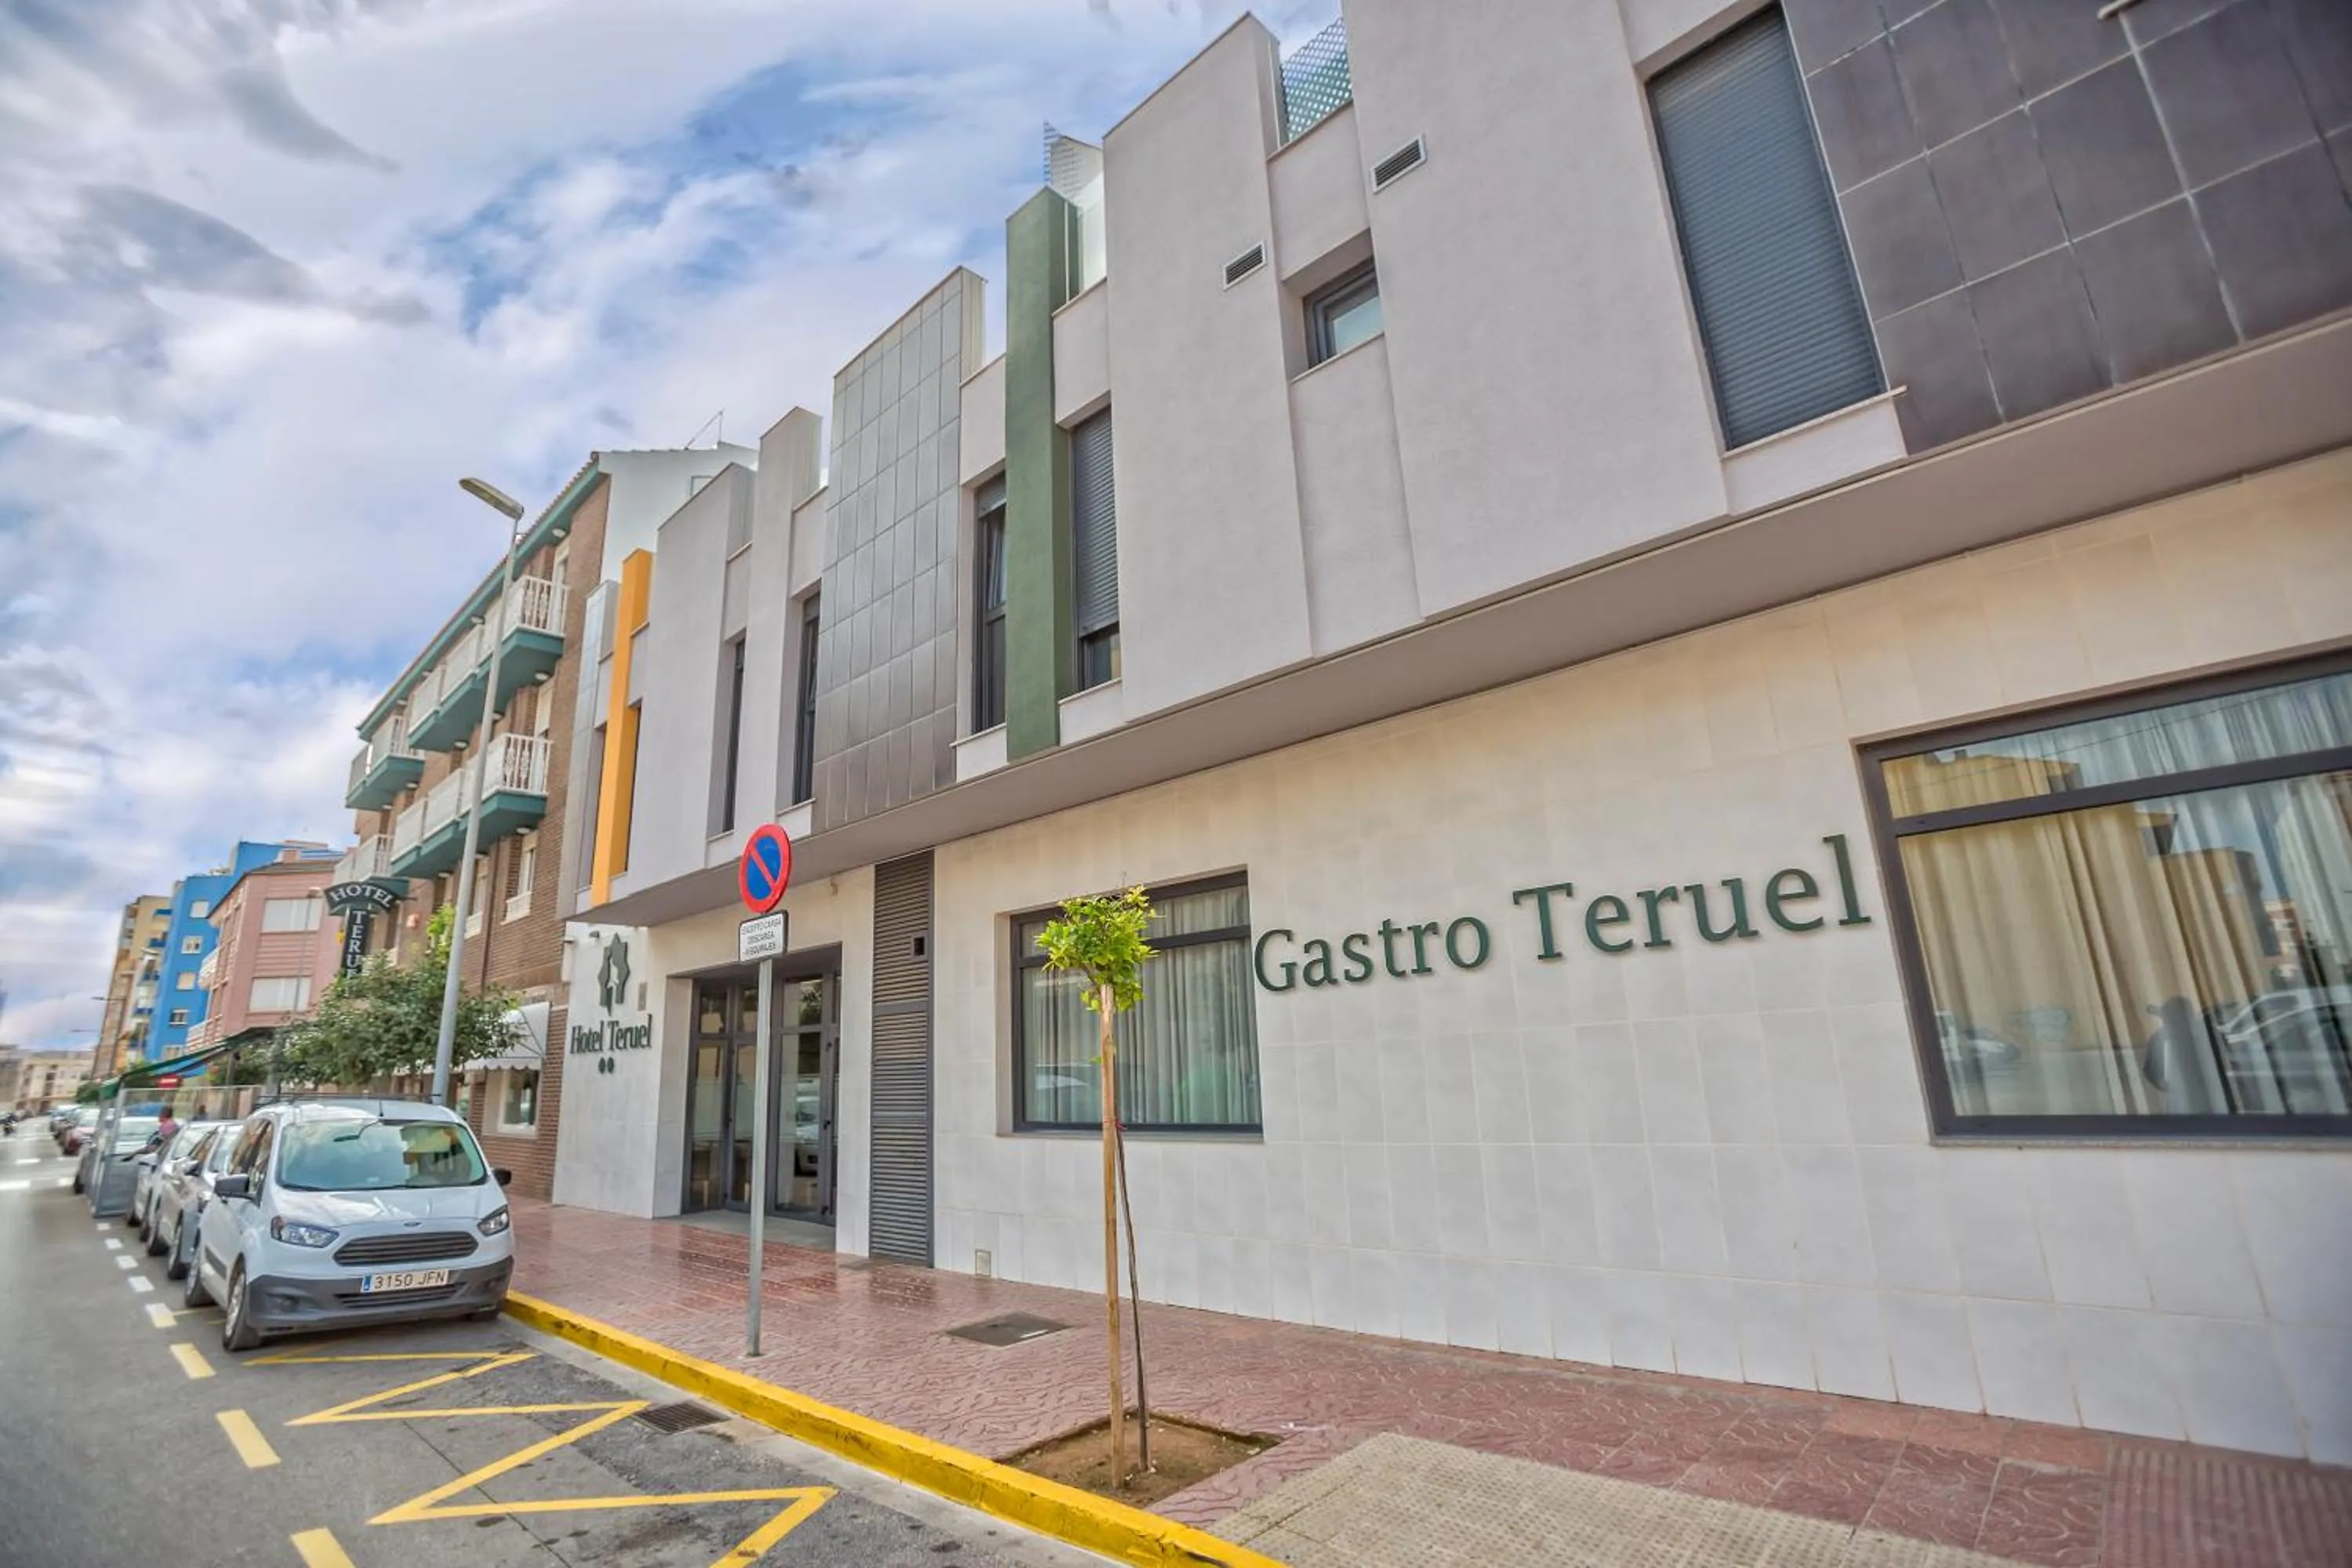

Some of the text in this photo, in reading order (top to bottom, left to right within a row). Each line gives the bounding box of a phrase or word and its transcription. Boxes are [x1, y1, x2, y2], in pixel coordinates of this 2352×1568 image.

[330, 884, 393, 907] HOTEL
[1254, 833, 1871, 993] Gastro Teruel
[570, 1013, 652, 1054] Hotel Teruel
[374, 1270, 446, 1290] 3150 JFN
